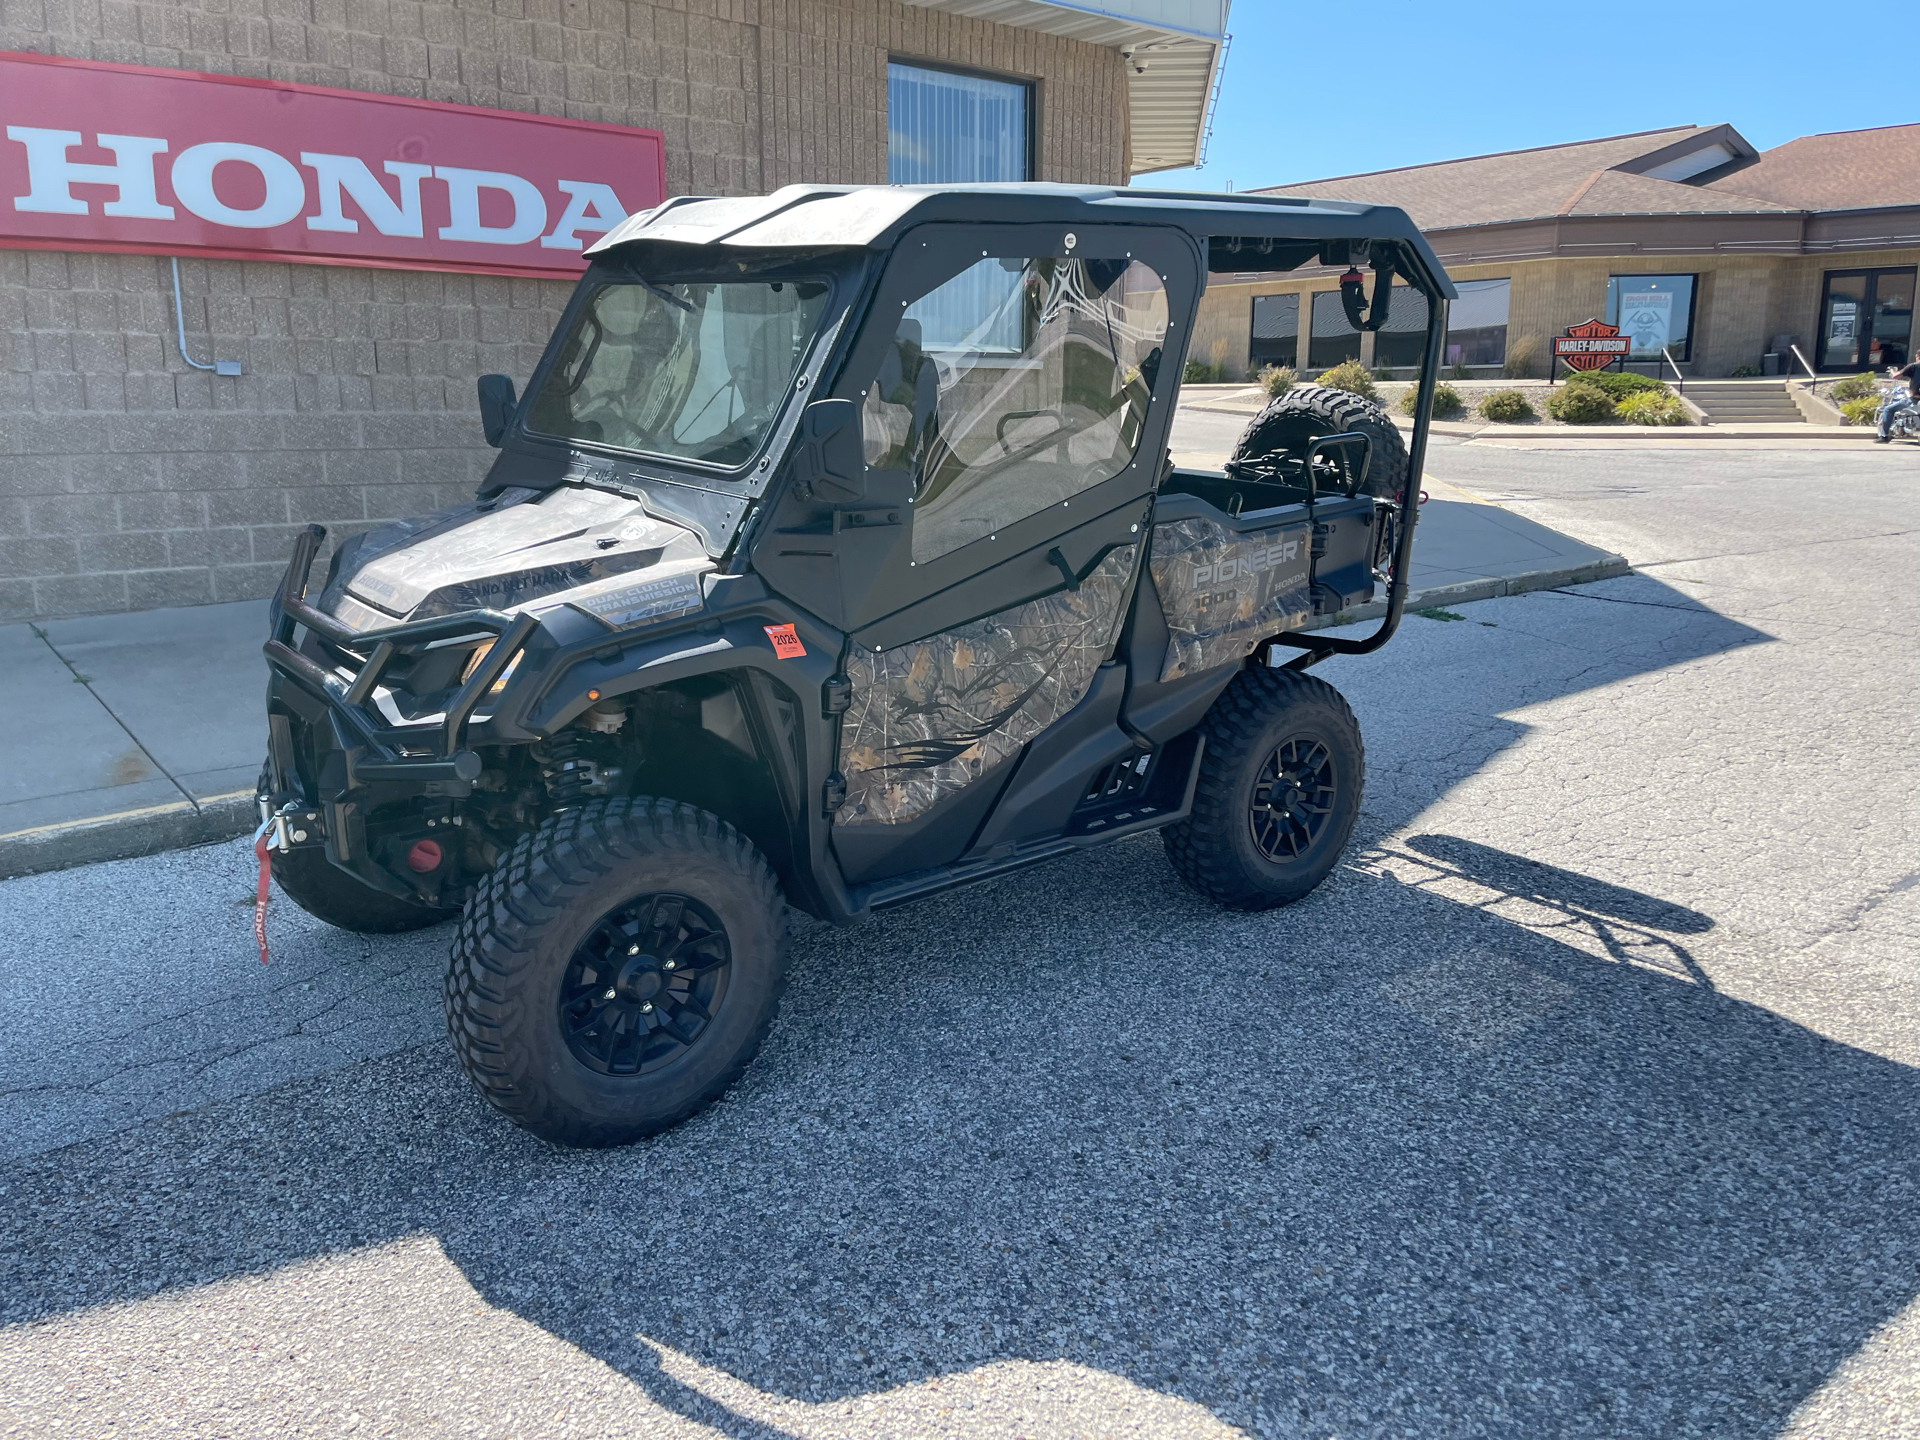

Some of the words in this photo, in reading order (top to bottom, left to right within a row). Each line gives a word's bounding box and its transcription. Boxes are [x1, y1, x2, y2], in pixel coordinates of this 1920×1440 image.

[6, 125, 629, 250] HONDA
[1575, 325, 1612, 337] MOTOR
[1558, 340, 1627, 352] HARLEY-DAVIDSON
[1573, 355, 1610, 369] CYCLES
[1193, 540, 1298, 589] PIONEER
[357, 573, 396, 597] HONDA
[482, 584, 500, 597] NO
[1274, 572, 1307, 591] HONDA
[586, 593, 623, 607] DUAL
[626, 579, 679, 596] CLUTCH
[592, 583, 696, 613] TRANSMISSION
[1194, 588, 1237, 609] 1000
[773, 634, 798, 646] 2026
[255, 901, 267, 950] HONDA
